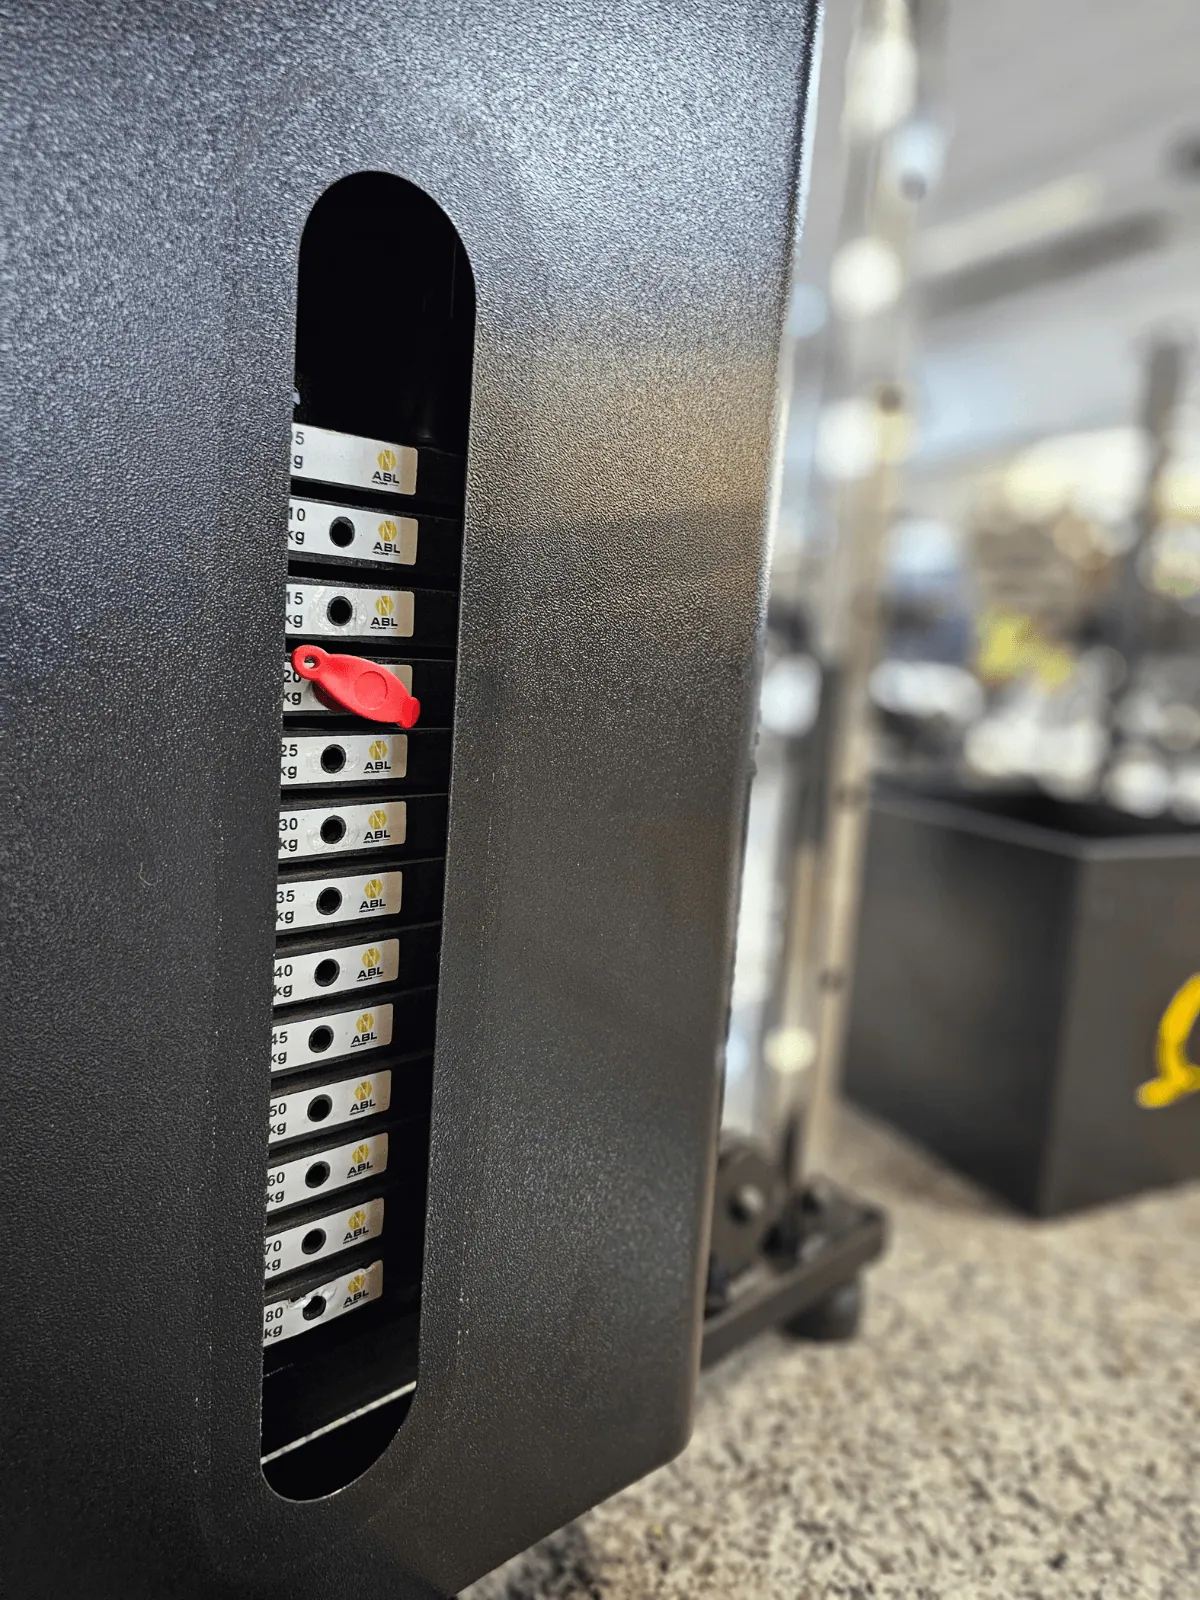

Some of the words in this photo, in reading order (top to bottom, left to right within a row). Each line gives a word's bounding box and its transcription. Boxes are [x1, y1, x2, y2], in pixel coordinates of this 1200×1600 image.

[295, 431, 305, 445] 5
[372, 471, 400, 484] ABL
[288, 506, 306, 521] 10
[372, 542, 401, 554] ABL
[286, 591, 303, 605] 15
[370, 617, 398, 627] ABL
[283, 692, 302, 705] kg
[281, 744, 298, 757] 25
[364, 761, 392, 771] ABL
[279, 818, 298, 831] 30
[364, 830, 391, 840] ABL
[279, 838, 298, 852] kg
[276, 890, 295, 904] 35
[359, 899, 387, 910] ABL
[274, 964, 293, 978] 40
[357, 967, 384, 979] ABL
[271, 1031, 288, 1045] 45
[351, 1032, 378, 1045] ABL
[269, 1102, 287, 1117] 50
[349, 1099, 376, 1112] ABL
[347, 1161, 373, 1176] ABL
[267, 1171, 285, 1187] 60
[343, 1226, 370, 1241] ABL
[265, 1240, 282, 1255] 70
[343, 1289, 370, 1306] ABL
[264, 1306, 284, 1323] 80
[264, 1325, 283, 1339] kg
